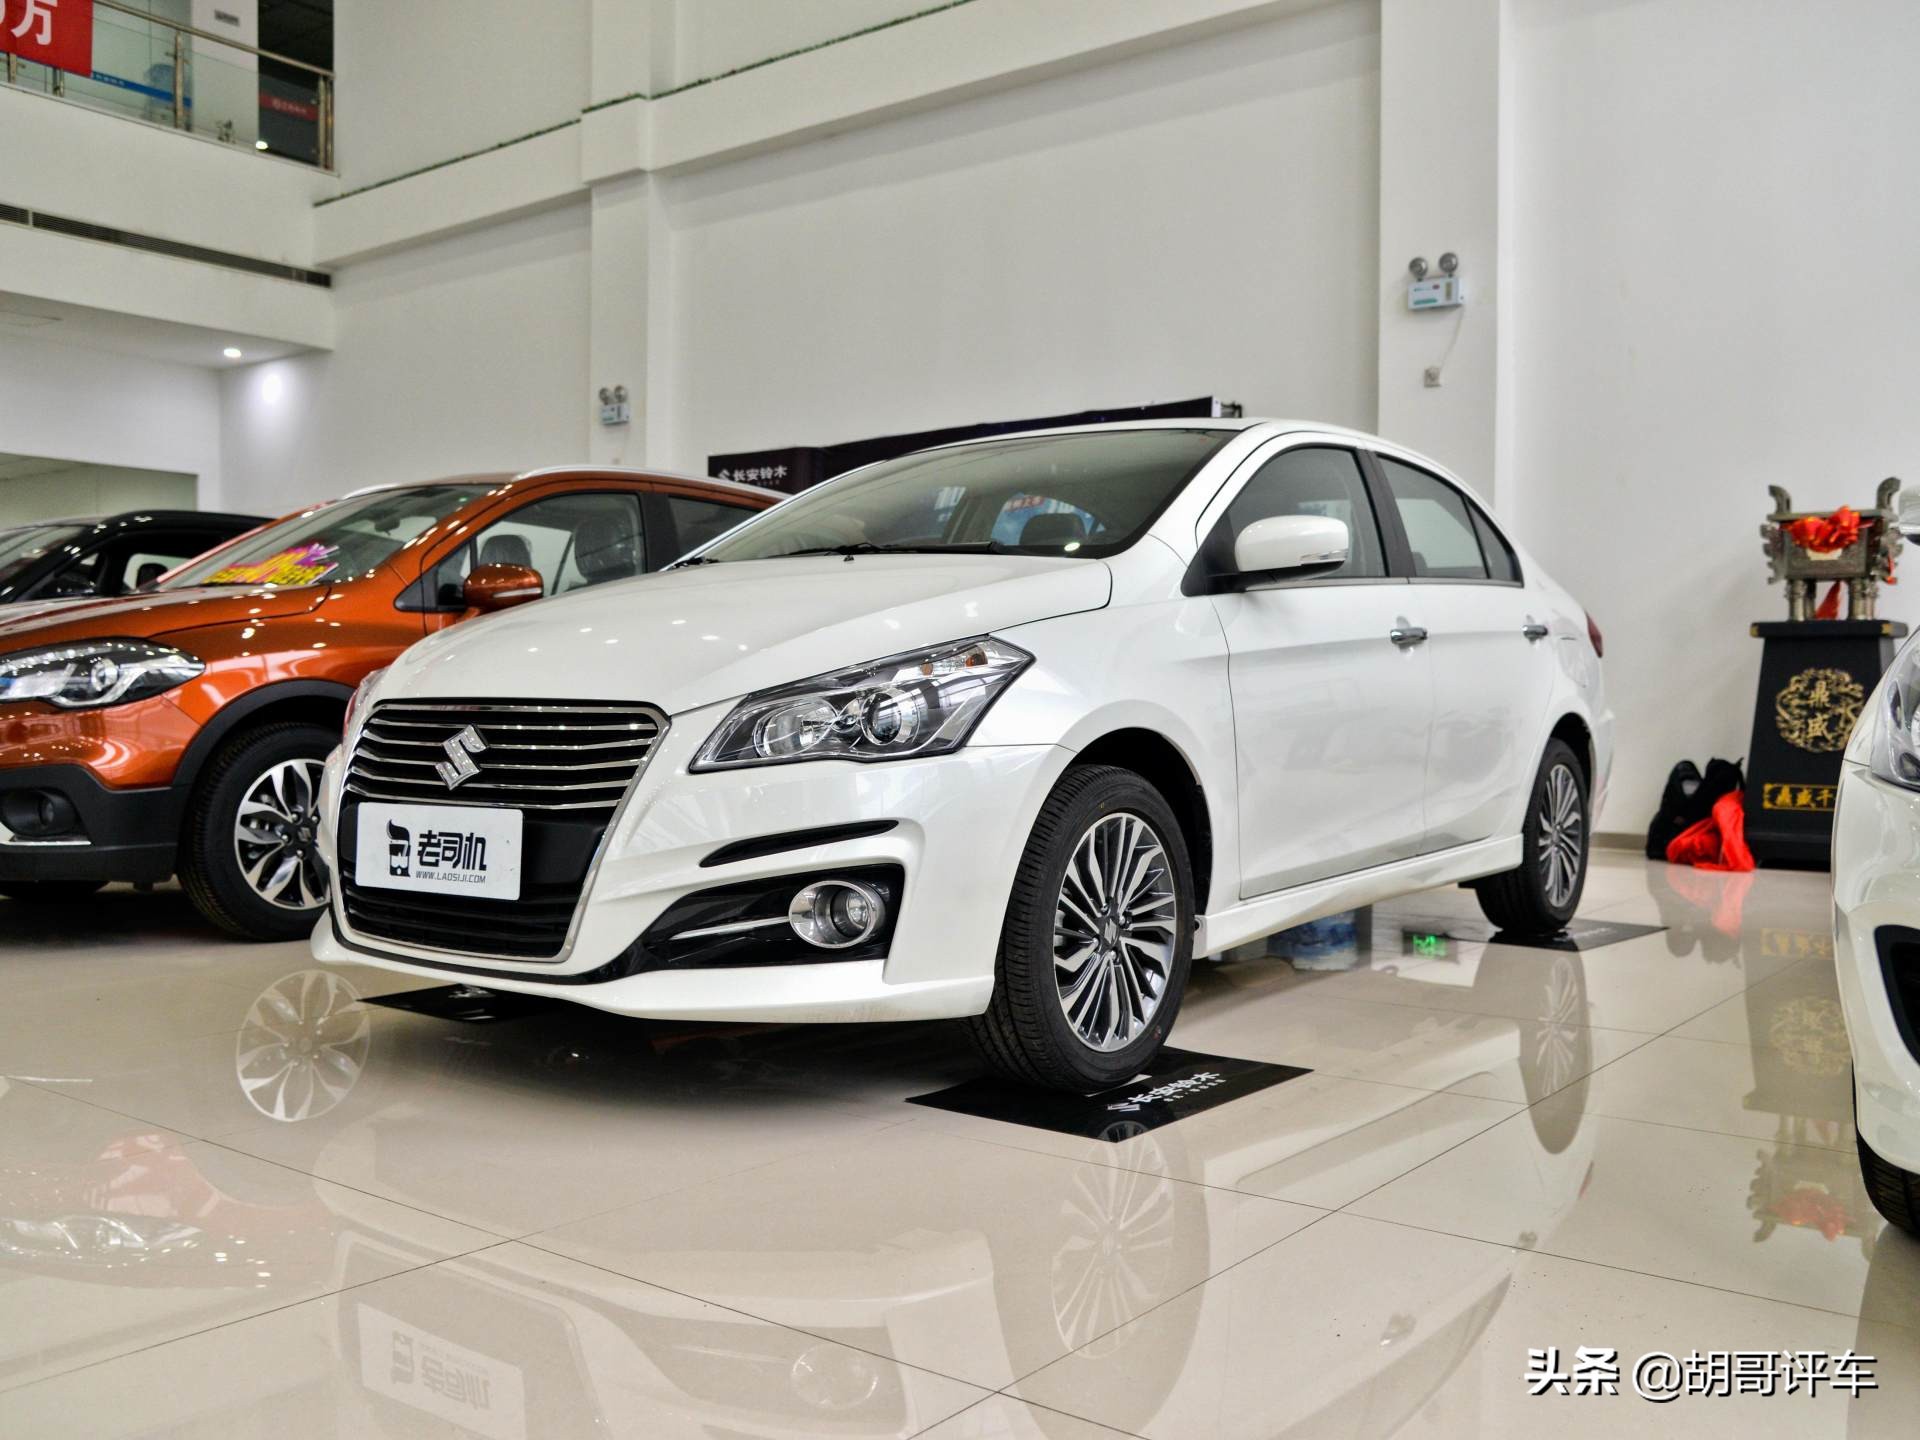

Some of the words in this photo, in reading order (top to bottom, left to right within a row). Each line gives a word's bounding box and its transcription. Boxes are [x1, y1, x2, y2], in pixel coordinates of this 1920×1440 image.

[732, 465, 788, 482] 长安铃木
[417, 829, 487, 871] 老司机
[415, 870, 486, 884] WWW.LAOSIJI.COM
